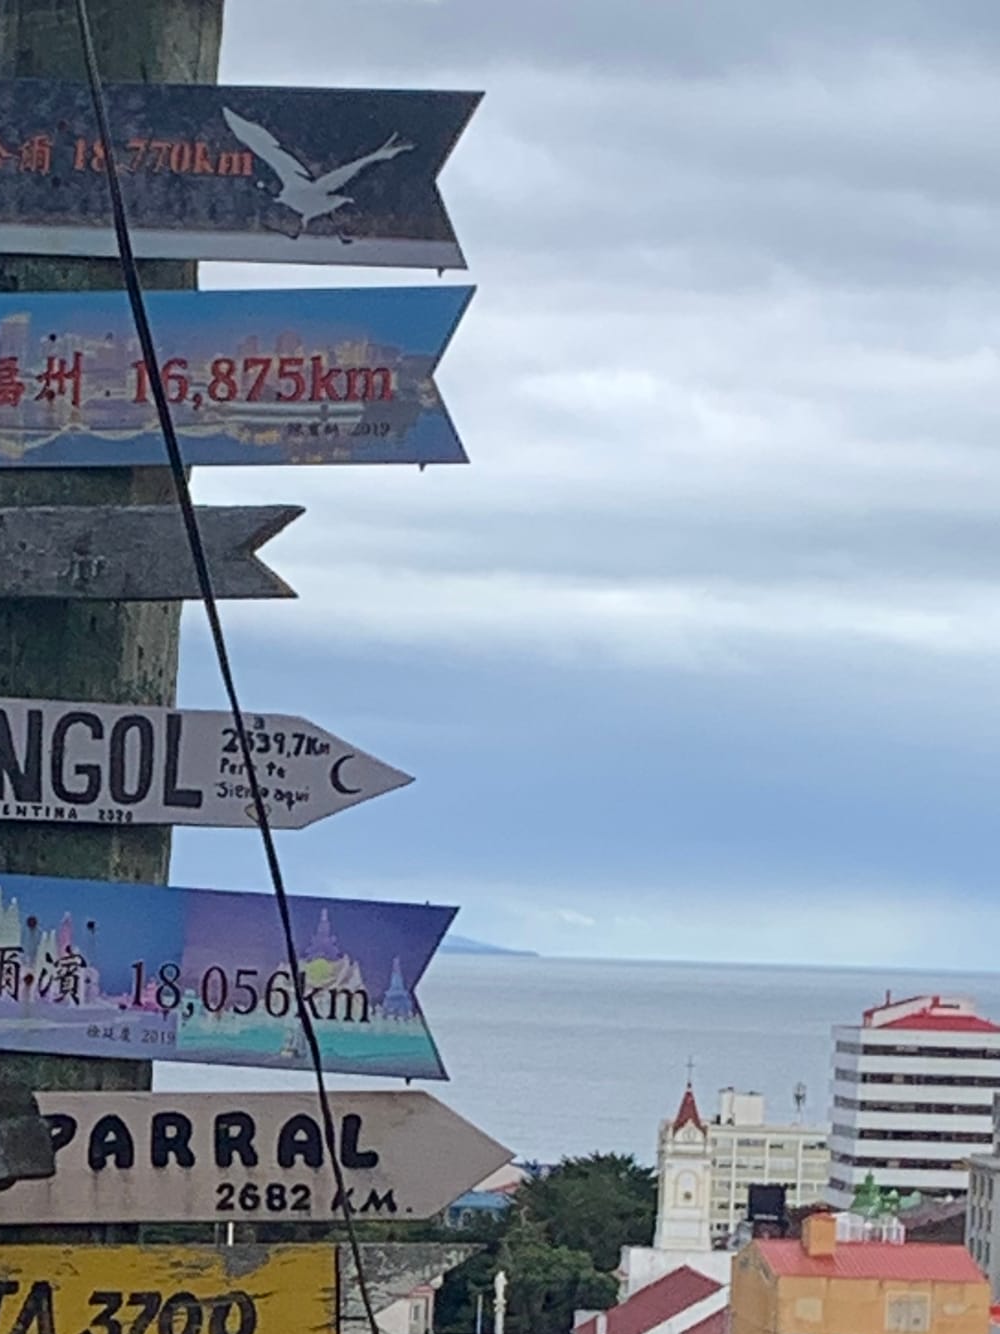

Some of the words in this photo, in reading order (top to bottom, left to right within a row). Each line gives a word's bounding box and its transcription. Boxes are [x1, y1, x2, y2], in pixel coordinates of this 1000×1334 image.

[132, 355, 393, 411] 16,875km
[131, 961, 372, 1023] 18,056km
[43, 1110, 379, 1171] PARRAL
[215, 1182, 312, 1213] 2682
